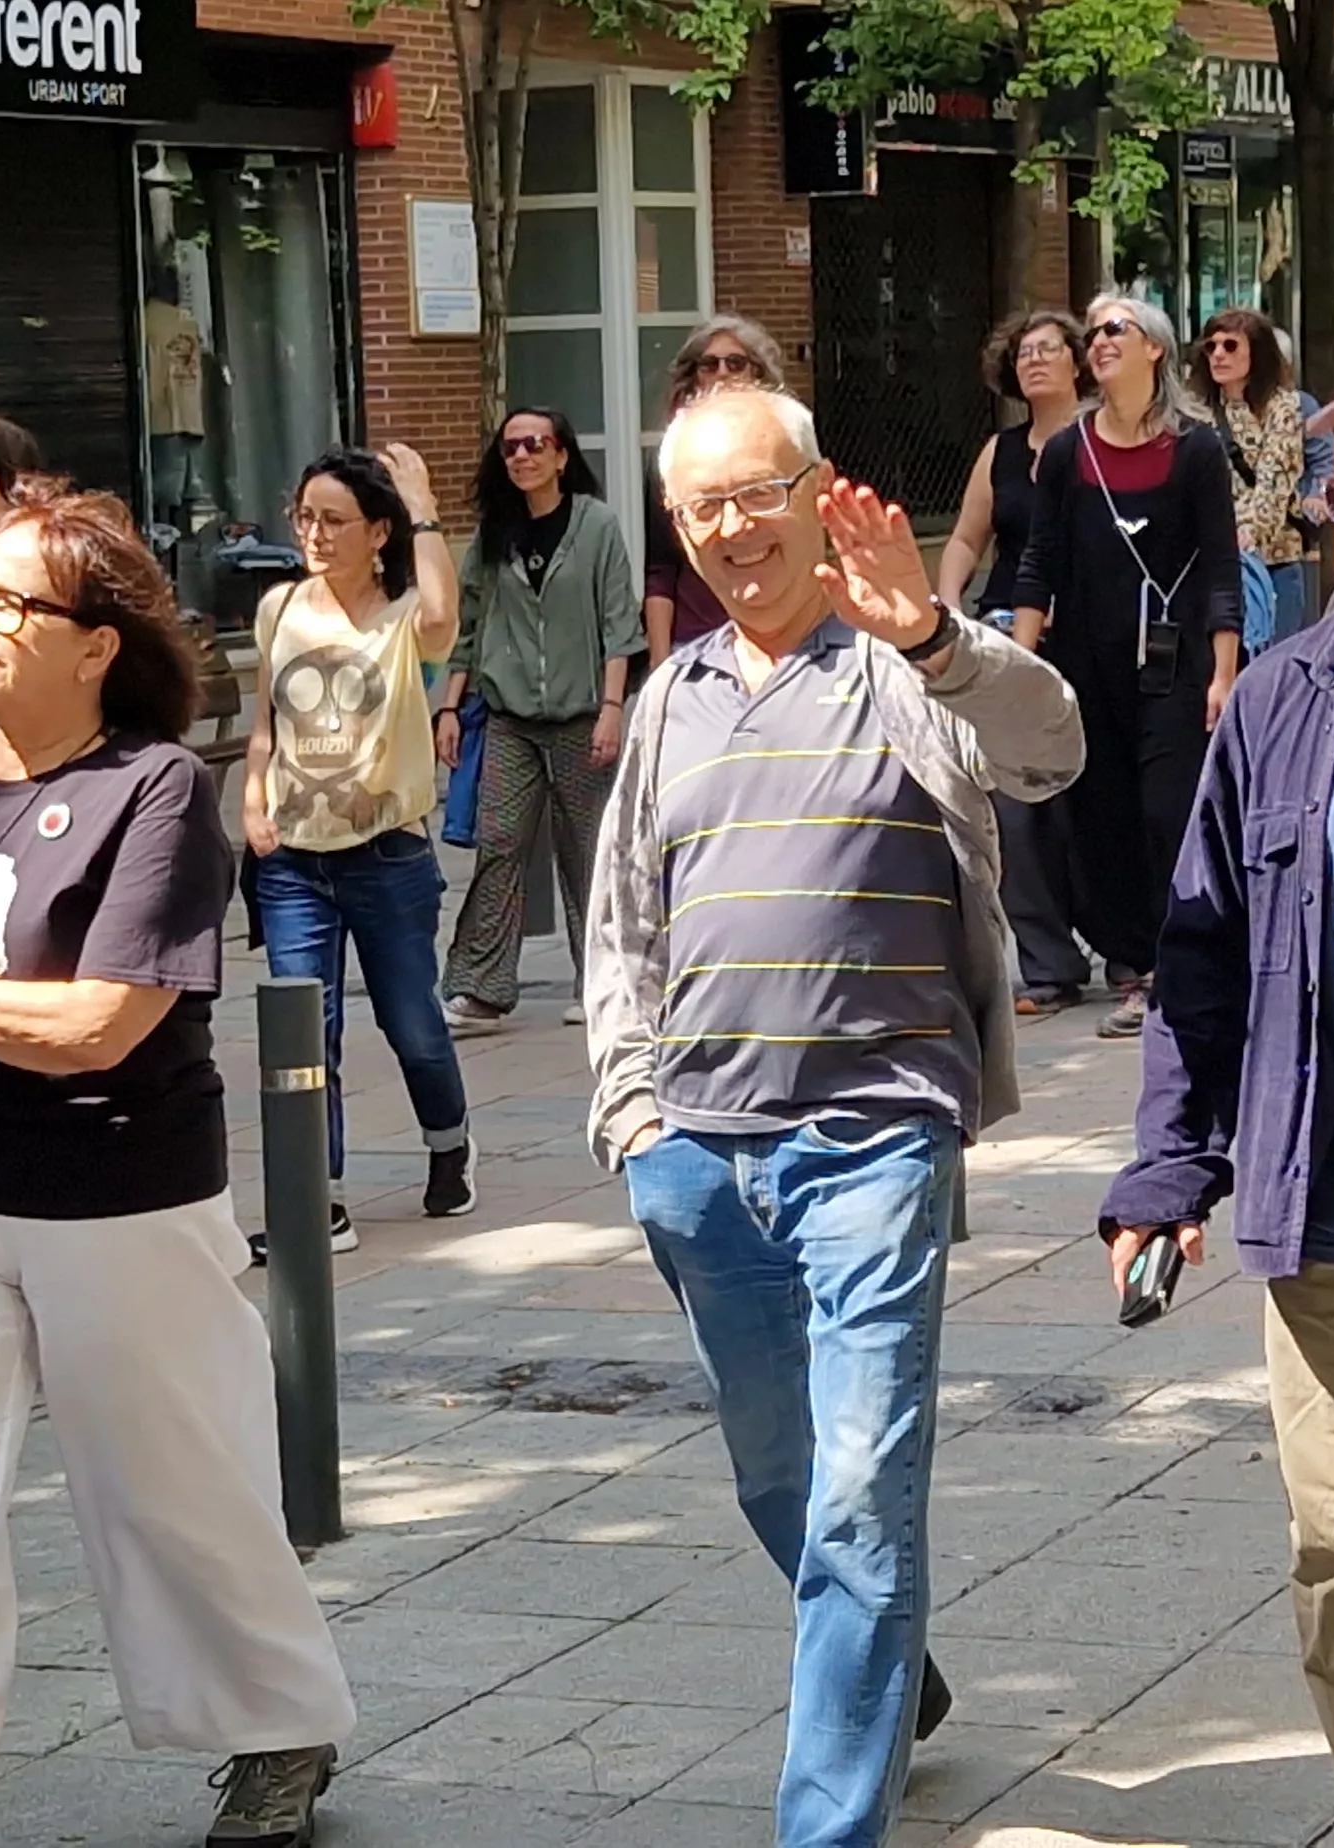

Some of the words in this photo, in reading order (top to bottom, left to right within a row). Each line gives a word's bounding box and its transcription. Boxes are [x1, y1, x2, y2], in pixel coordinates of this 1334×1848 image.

[28, 79, 78, 103] URBAN
[81, 82, 127, 106] SPORT
[886, 82, 937, 123] pablo
[1232, 63, 1292, 116] ALLU
